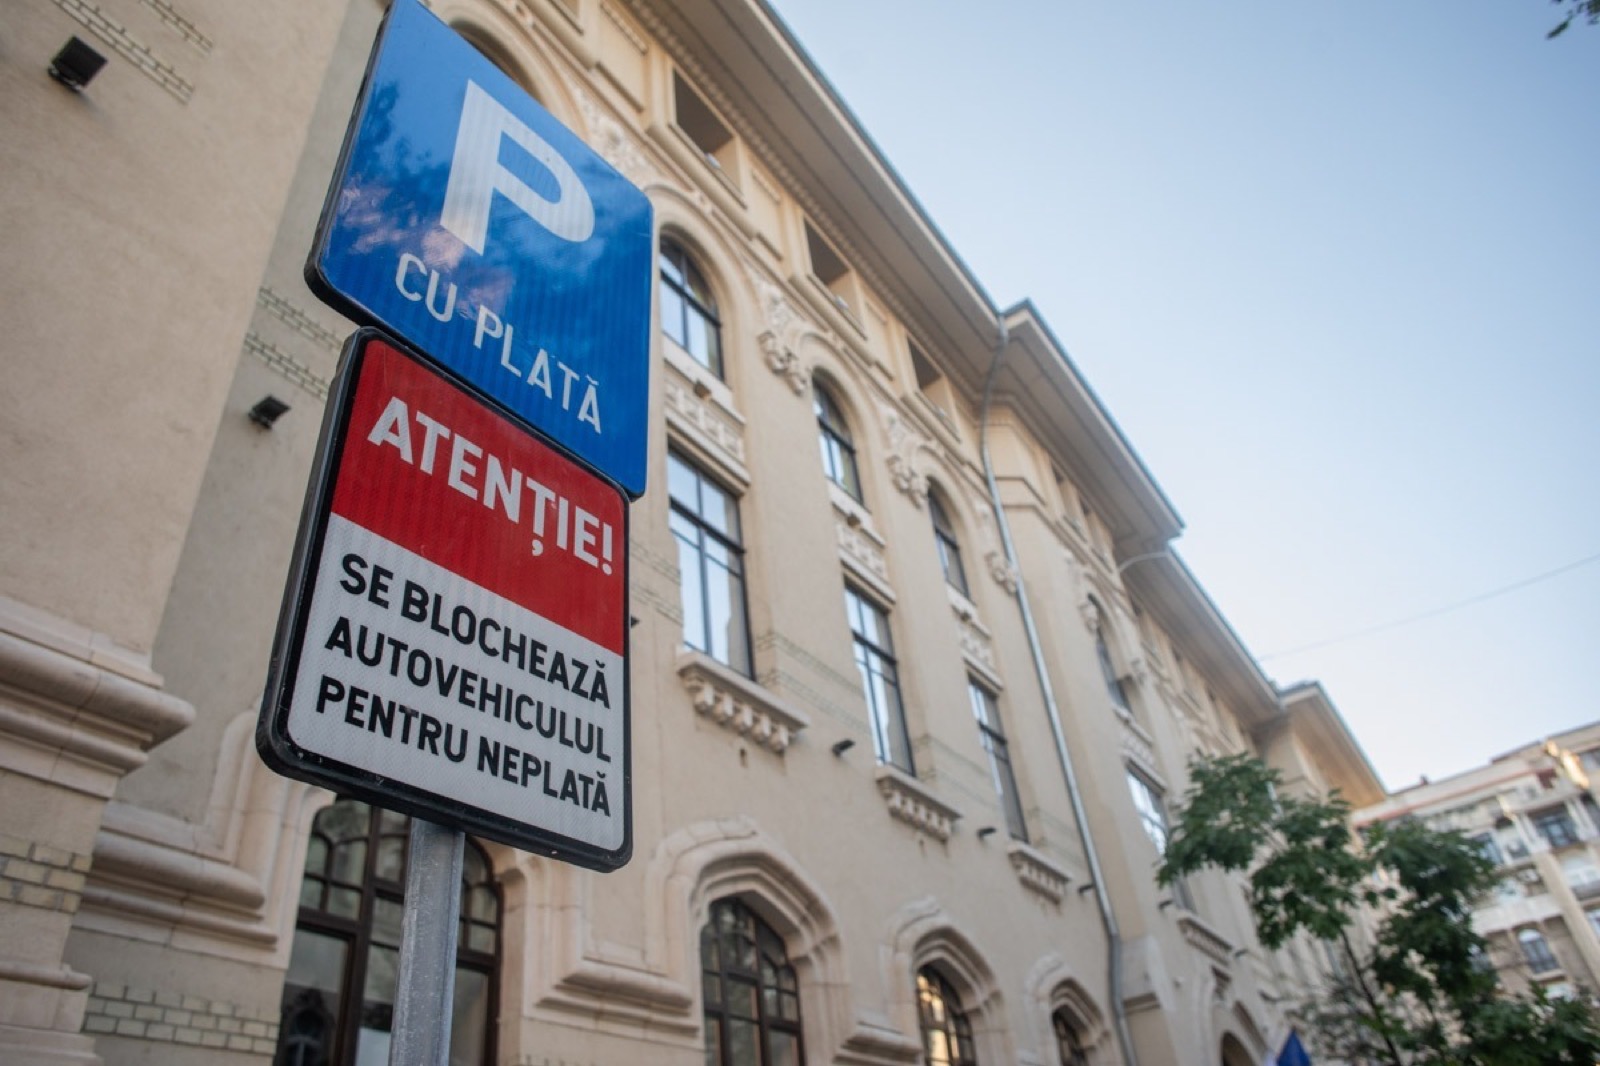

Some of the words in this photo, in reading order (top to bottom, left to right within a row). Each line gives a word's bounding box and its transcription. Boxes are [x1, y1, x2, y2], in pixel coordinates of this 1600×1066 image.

[440, 79, 595, 256] P
[395, 252, 457, 322] CU
[473, 304, 601, 435] PLATĂ
[366, 396, 613, 576] ATENȚIE!
[324, 617, 612, 763] AUTOVEHICULUL
[340, 552, 394, 608] SE
[401, 579, 611, 709] BLOCHEAZĂ
[315, 674, 469, 763] PENTRU
[477, 736, 611, 818] NEPLATĂ
